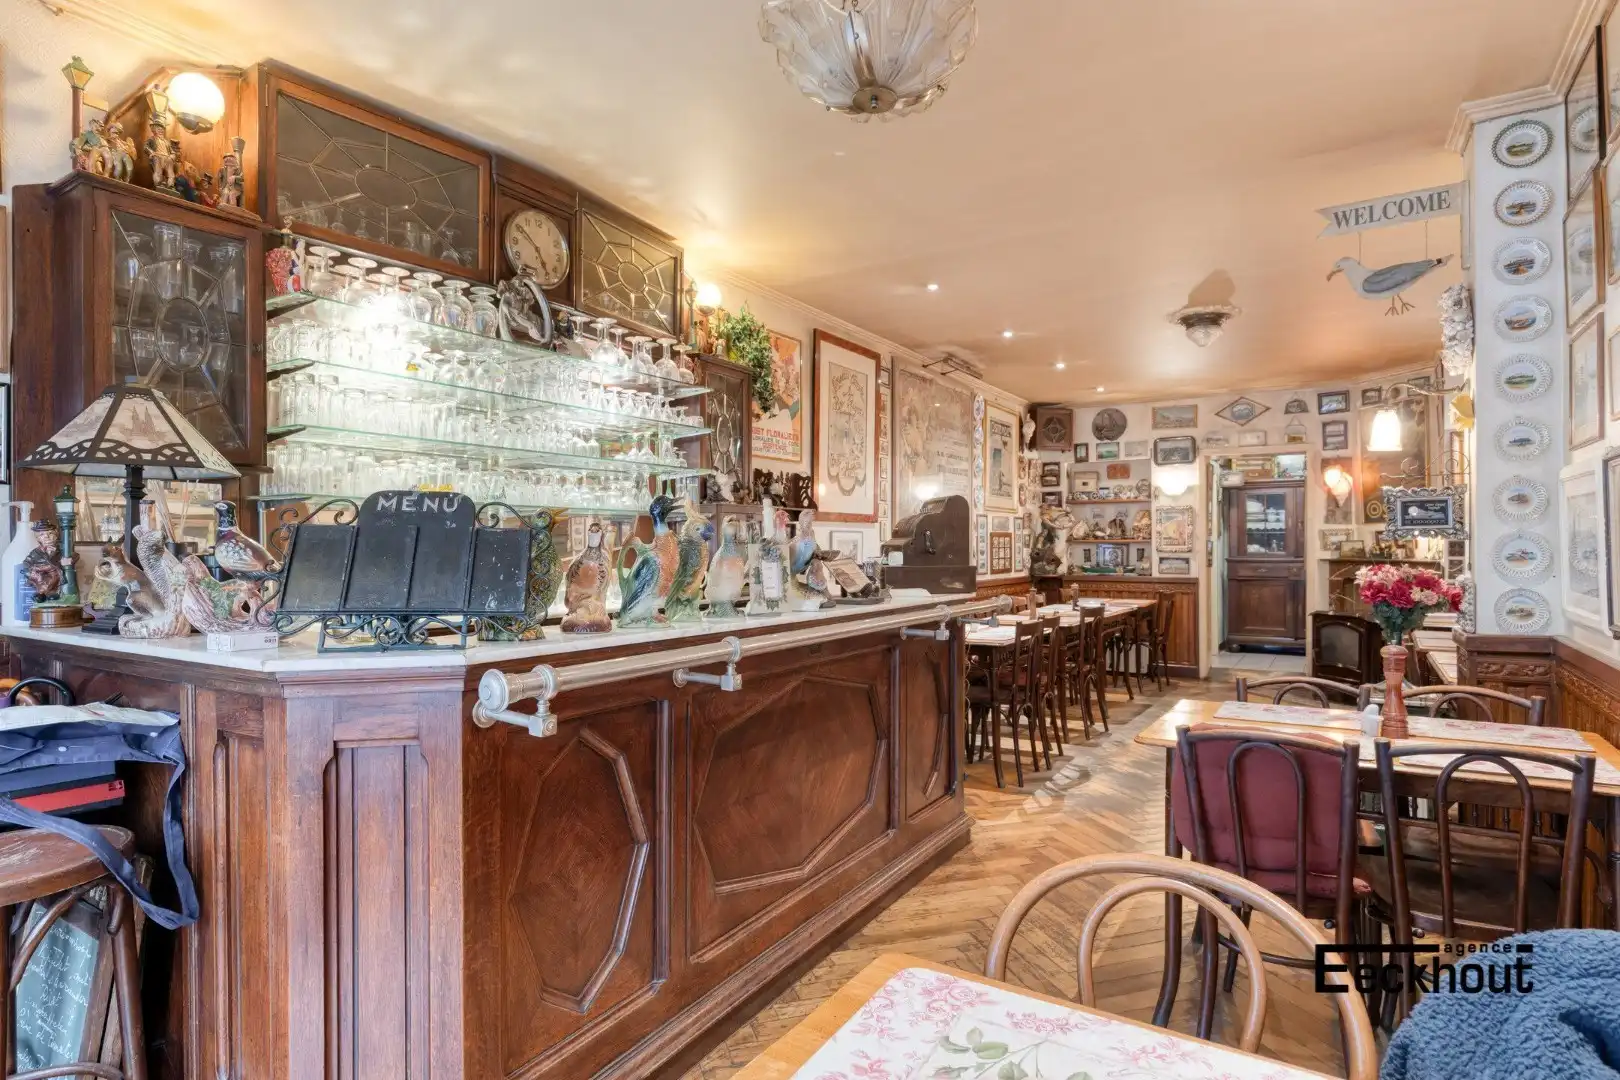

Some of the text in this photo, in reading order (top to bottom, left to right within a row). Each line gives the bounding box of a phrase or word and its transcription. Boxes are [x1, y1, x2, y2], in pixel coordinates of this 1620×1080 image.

[1333, 190, 1451, 229] WELCOME
[535, 219, 543, 229] 12
[512, 236, 519, 246] 9
[377, 493, 459, 512] MENU
